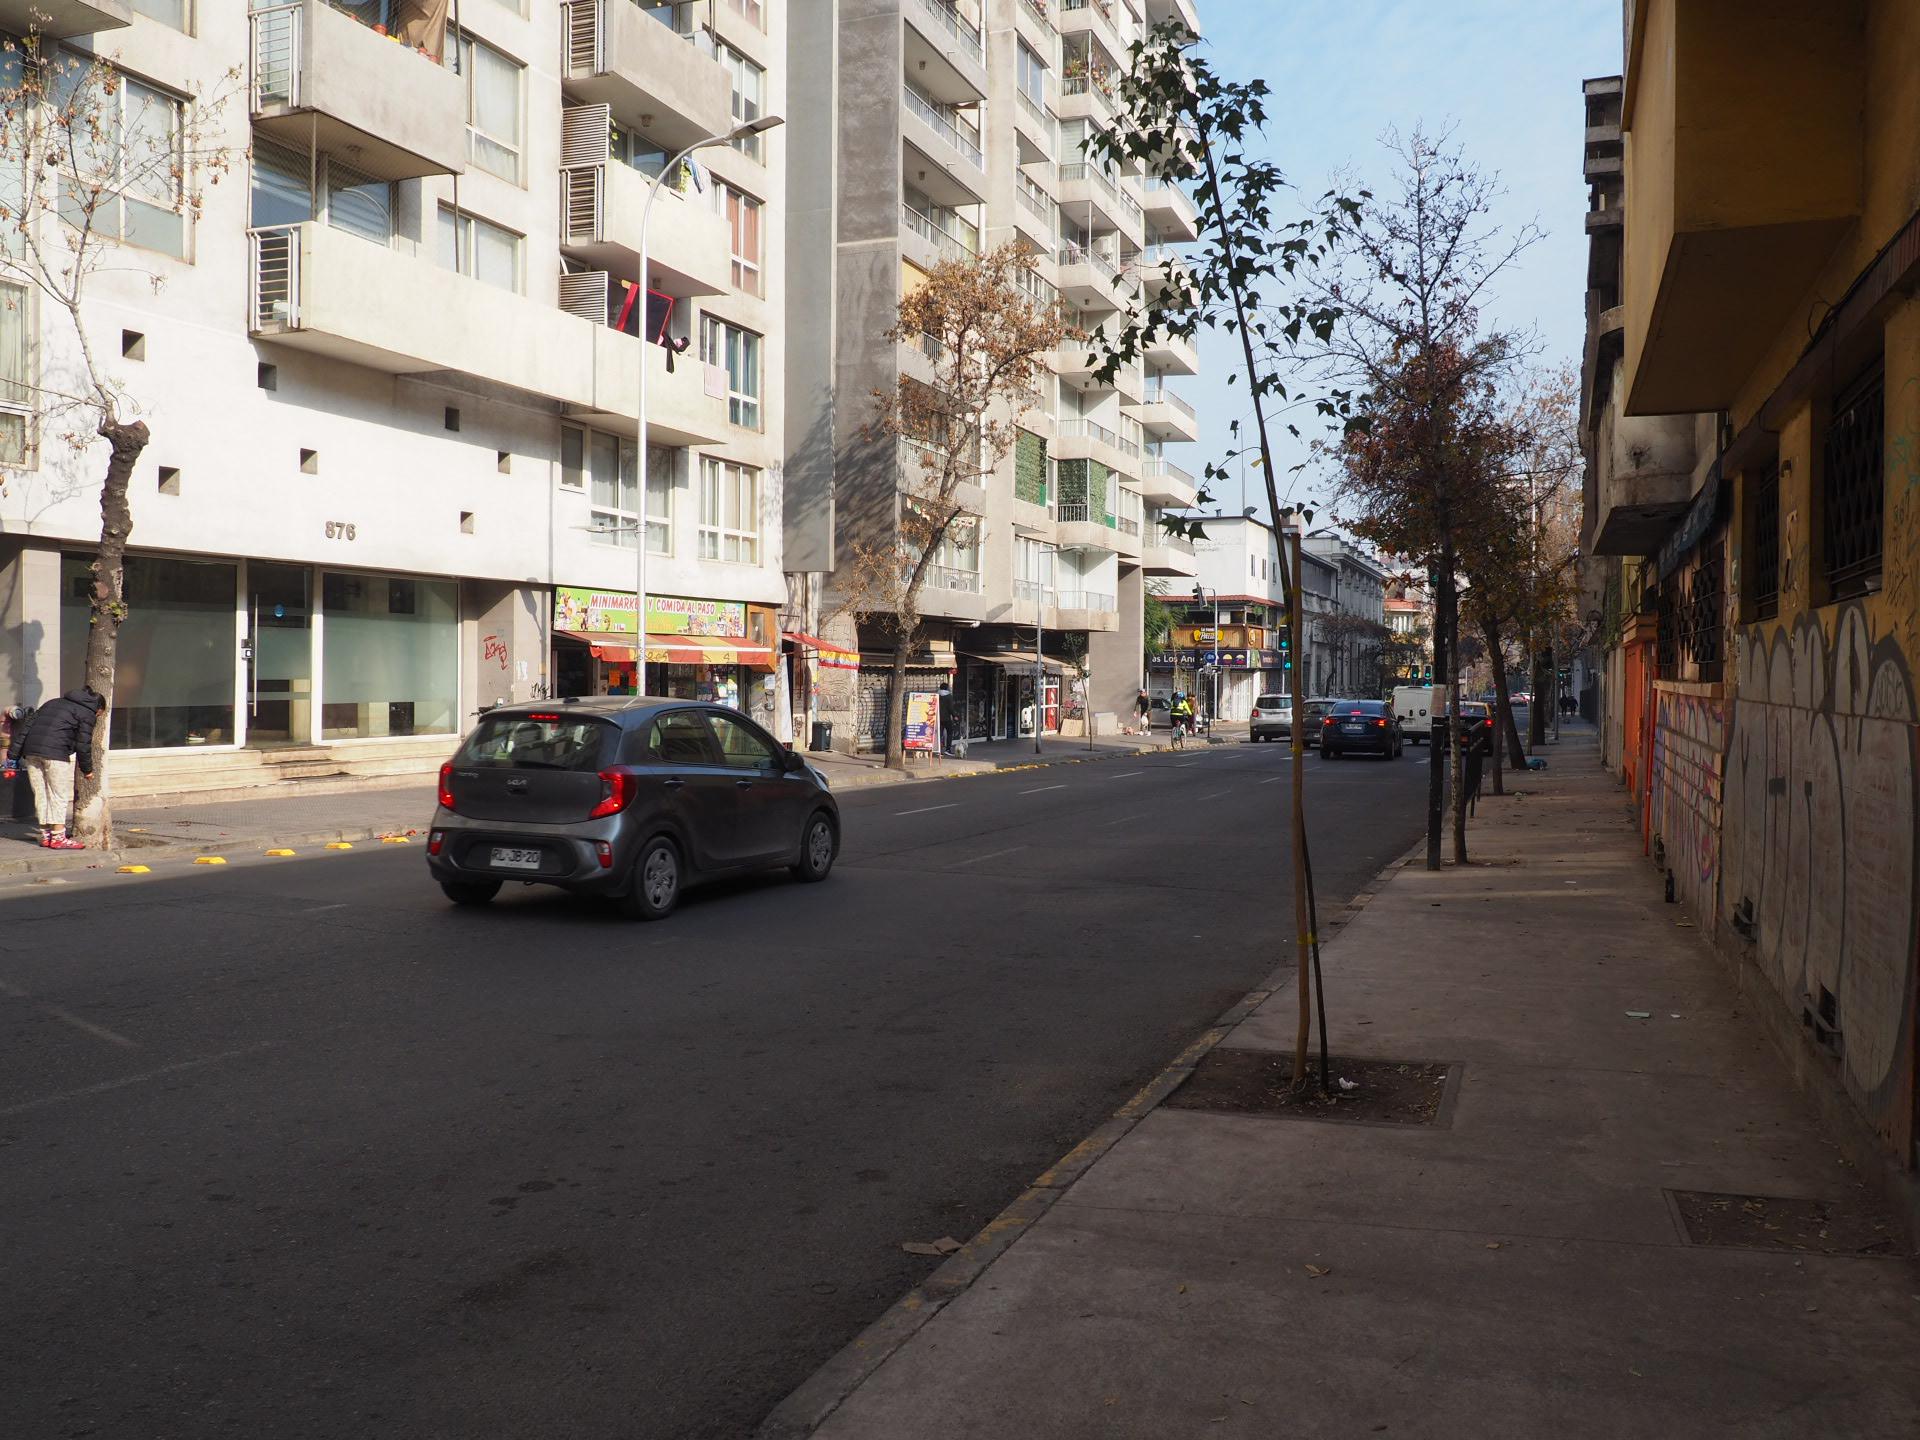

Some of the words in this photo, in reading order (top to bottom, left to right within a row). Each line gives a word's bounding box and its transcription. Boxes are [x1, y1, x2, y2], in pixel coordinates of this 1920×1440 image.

[324, 520, 357, 541] 876
[591, 595, 640, 610] MINIMARKE
[648, 598, 653, 610] Y
[656, 598, 686, 612] COMIDA
[687, 602, 696, 613] AL
[697, 603, 715, 615] PASO
